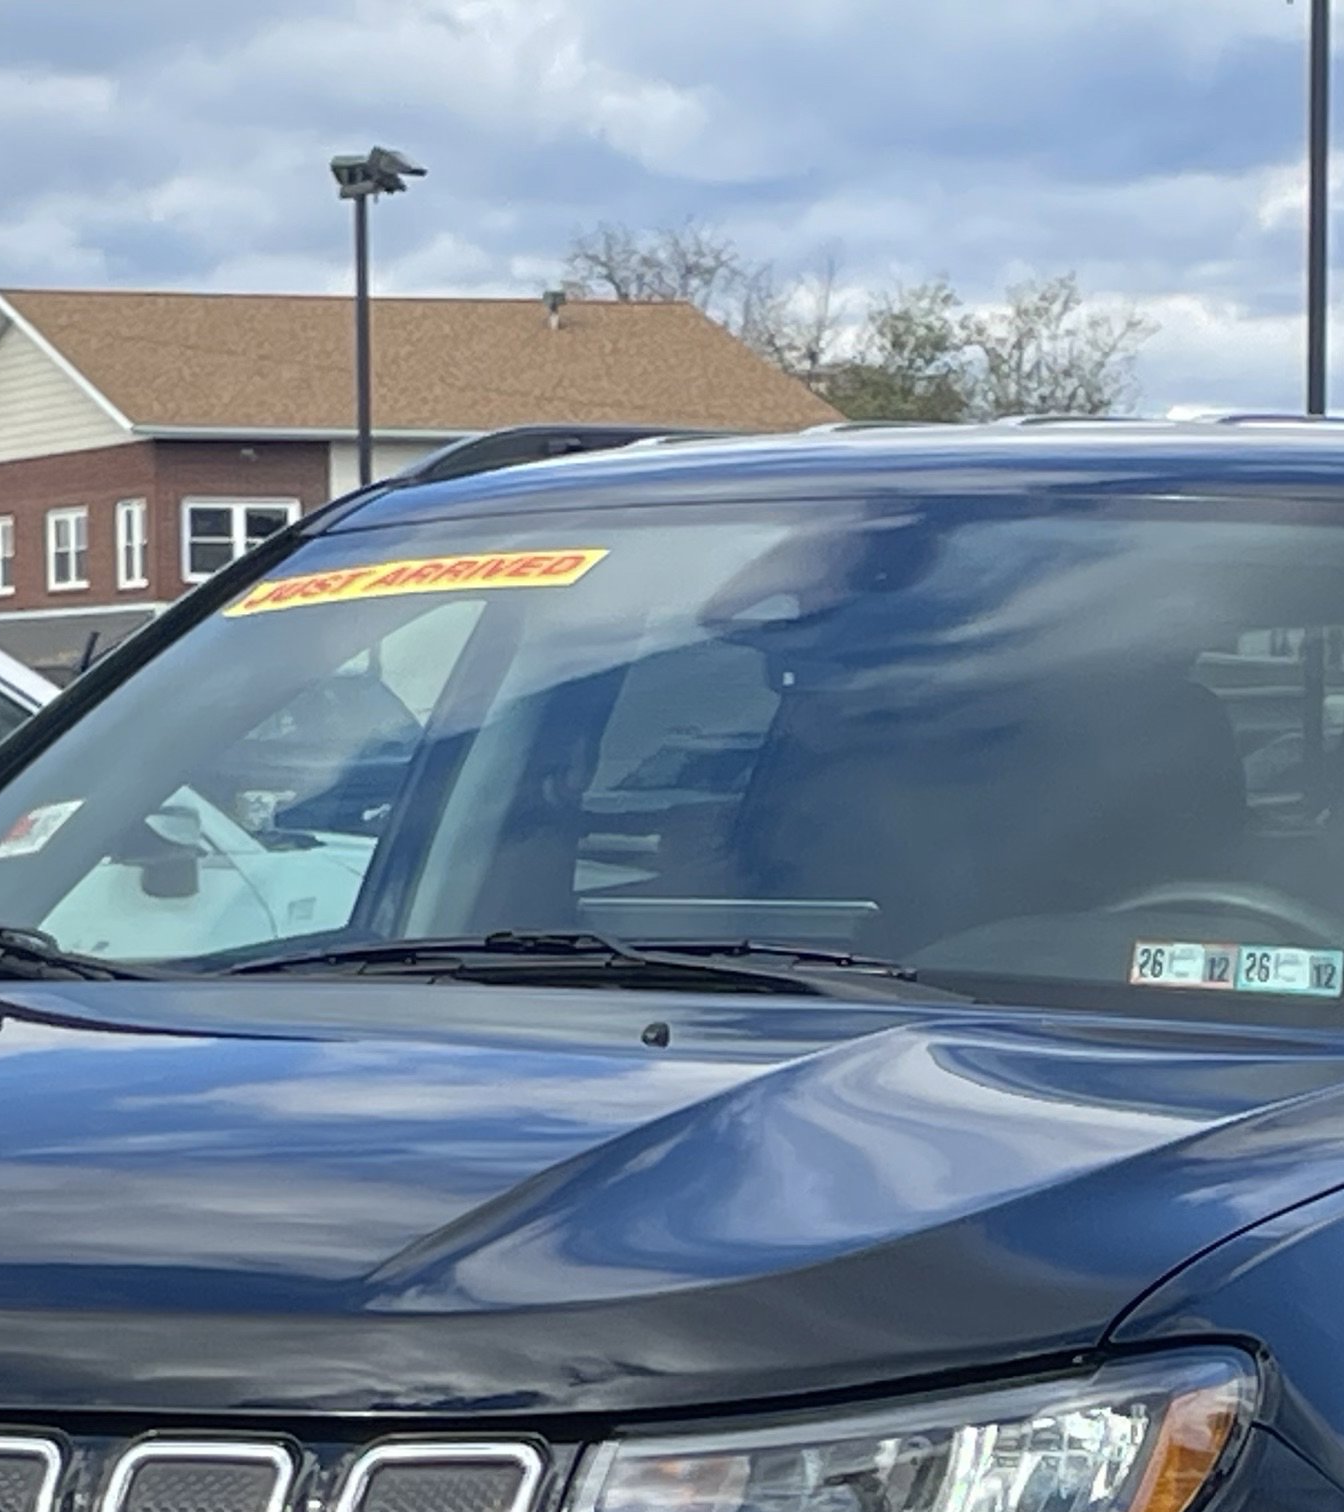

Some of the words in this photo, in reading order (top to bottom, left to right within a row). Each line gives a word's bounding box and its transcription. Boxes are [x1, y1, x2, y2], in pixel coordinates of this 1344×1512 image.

[243, 569, 376, 609] JUST
[364, 555, 585, 591] ARRIVED
[1139, 948, 1166, 978] 26
[1207, 956, 1231, 983] 12
[1245, 952, 1271, 983] 26
[1313, 963, 1337, 989] 12
